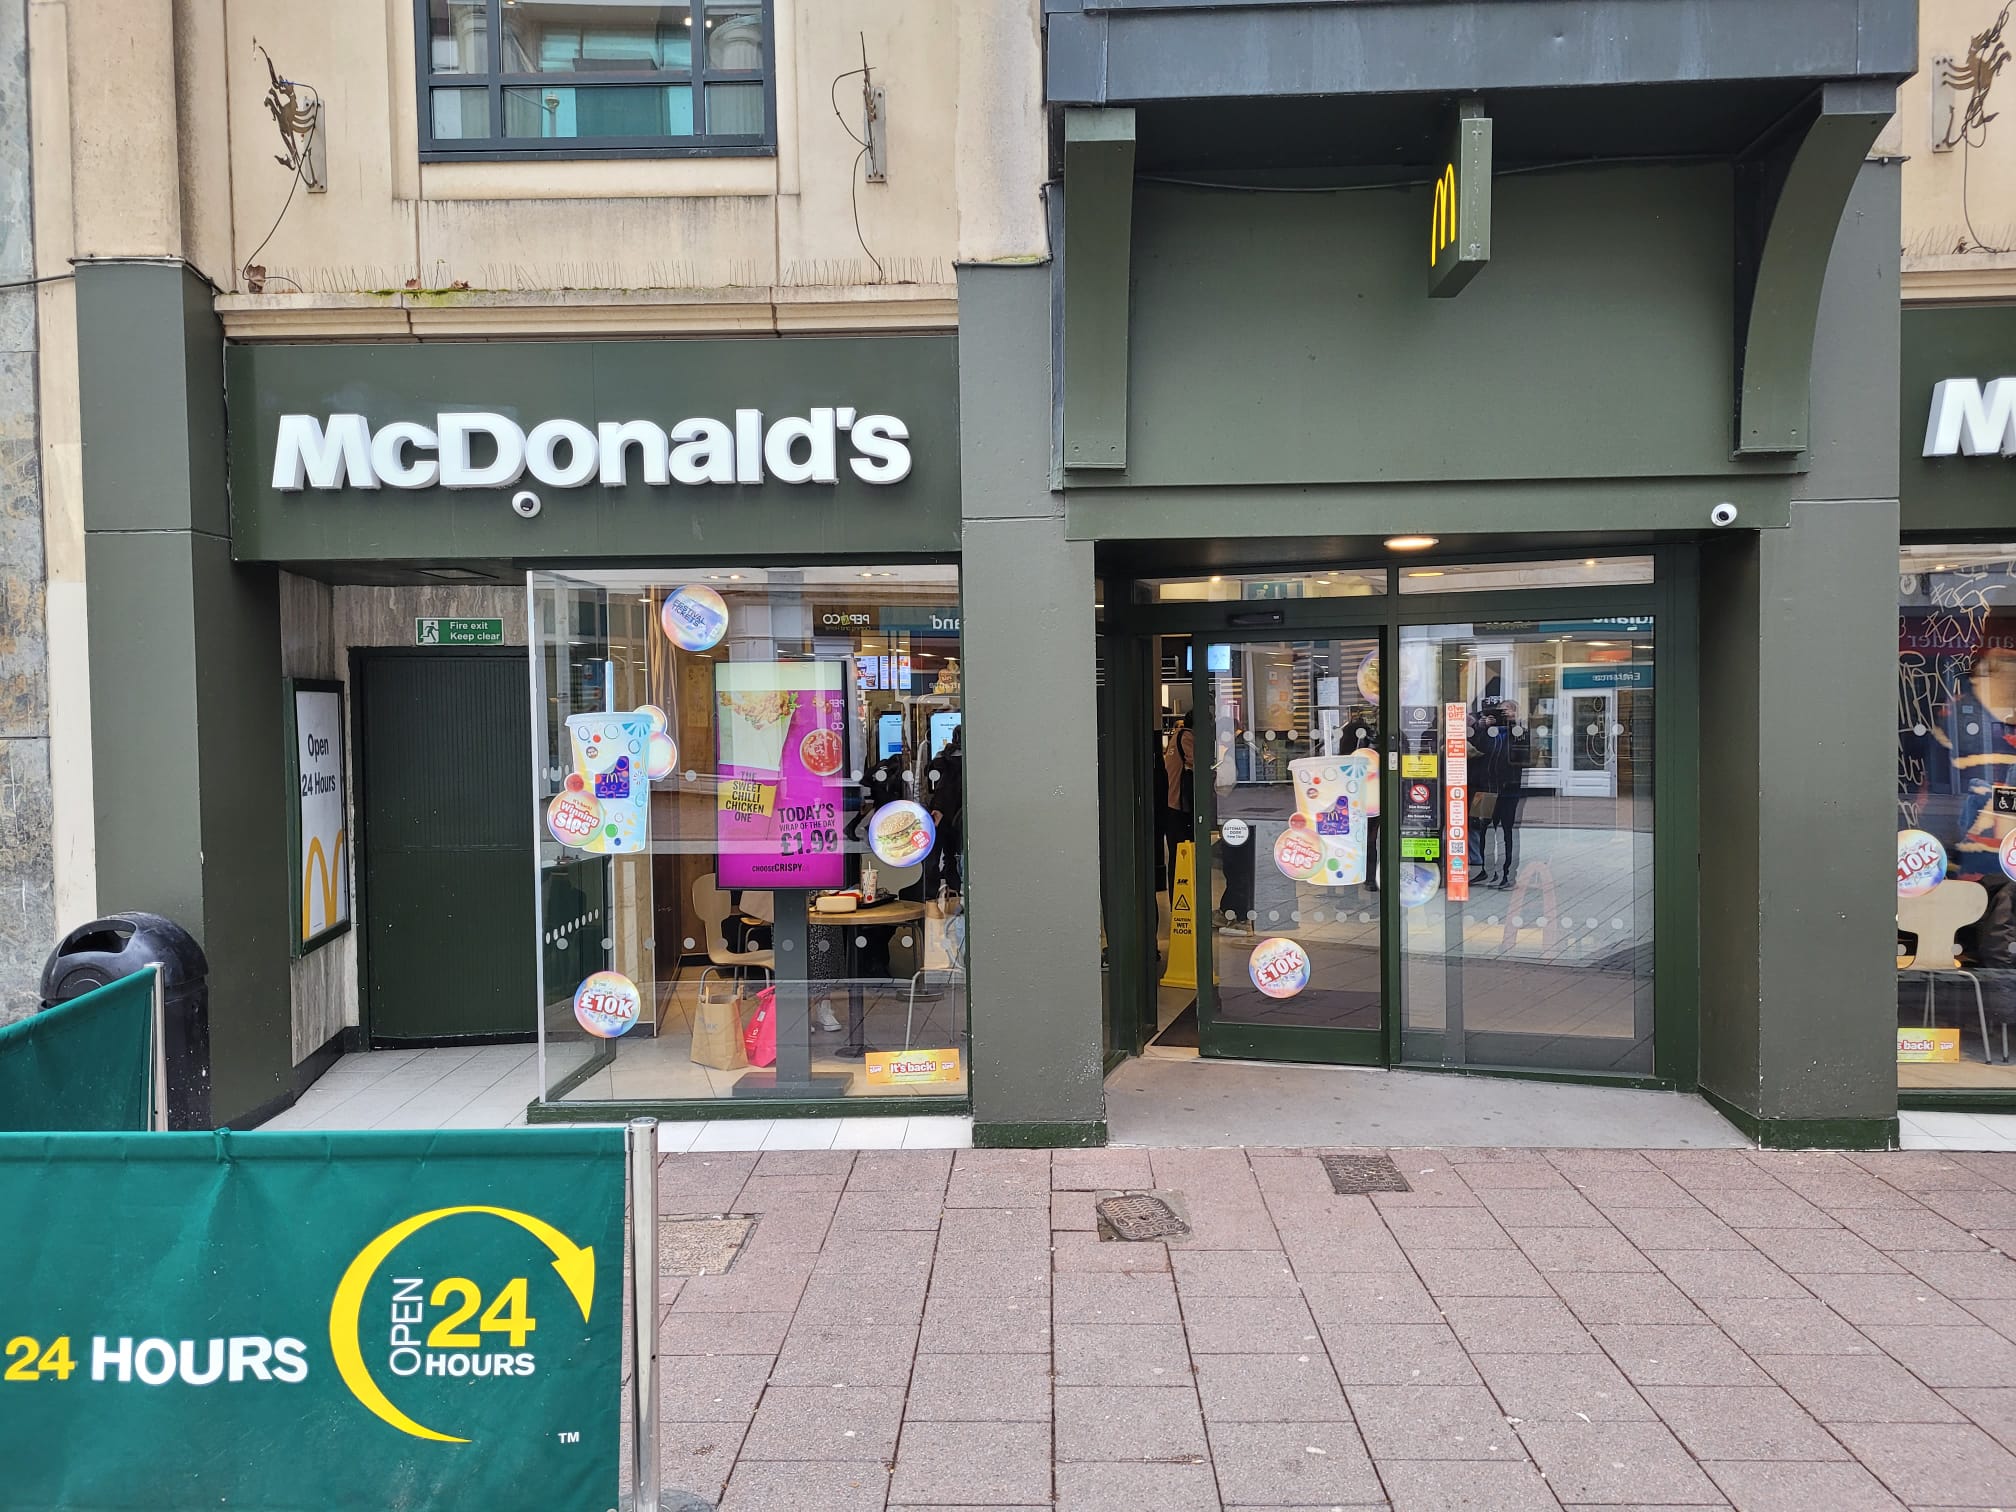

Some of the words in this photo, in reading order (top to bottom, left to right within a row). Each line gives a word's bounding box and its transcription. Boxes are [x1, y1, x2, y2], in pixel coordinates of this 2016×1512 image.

[271, 407, 912, 491] McDonald's
[450, 621, 468, 630] Fire
[470, 621, 488, 630] exit
[450, 631, 474, 642] Keep
[476, 631, 501, 641] clear
[307, 733, 329, 762] Open
[301, 774, 313, 797] 24
[315, 771, 336, 795] Hours
[733, 781, 761, 793] SWEET
[725, 800, 765, 814] CHICKEN
[731, 791, 761, 803] CHILLI
[554, 811, 592, 836] Sips
[561, 801, 600, 827] Winning
[734, 811, 752, 823] ONE
[777, 803, 835, 823] TODAY'S
[779, 823, 799, 832] WRAP
[800, 822, 809, 830] OF
[809, 820, 822, 829] THE
[822, 819, 836, 828] DAY
[780, 829, 839, 857] £1.99
[1285, 838, 1321, 862] Winning
[1280, 848, 1314, 870] Sips
[1256, 950, 1304, 987] £10K
[579, 990, 634, 1019] £10K
[1902, 1040, 1935, 1051] back!
[889, 1062, 906, 1074] It's
[906, 1061, 937, 1073] back!
[428, 1277, 536, 1349] 24
[390, 1277, 424, 1377] OPEN
[4, 1336, 77, 1381] 24
[91, 1336, 309, 1385] HOURS
[426, 1353, 536, 1377] HOURS
[558, 1432, 580, 1444] TM
